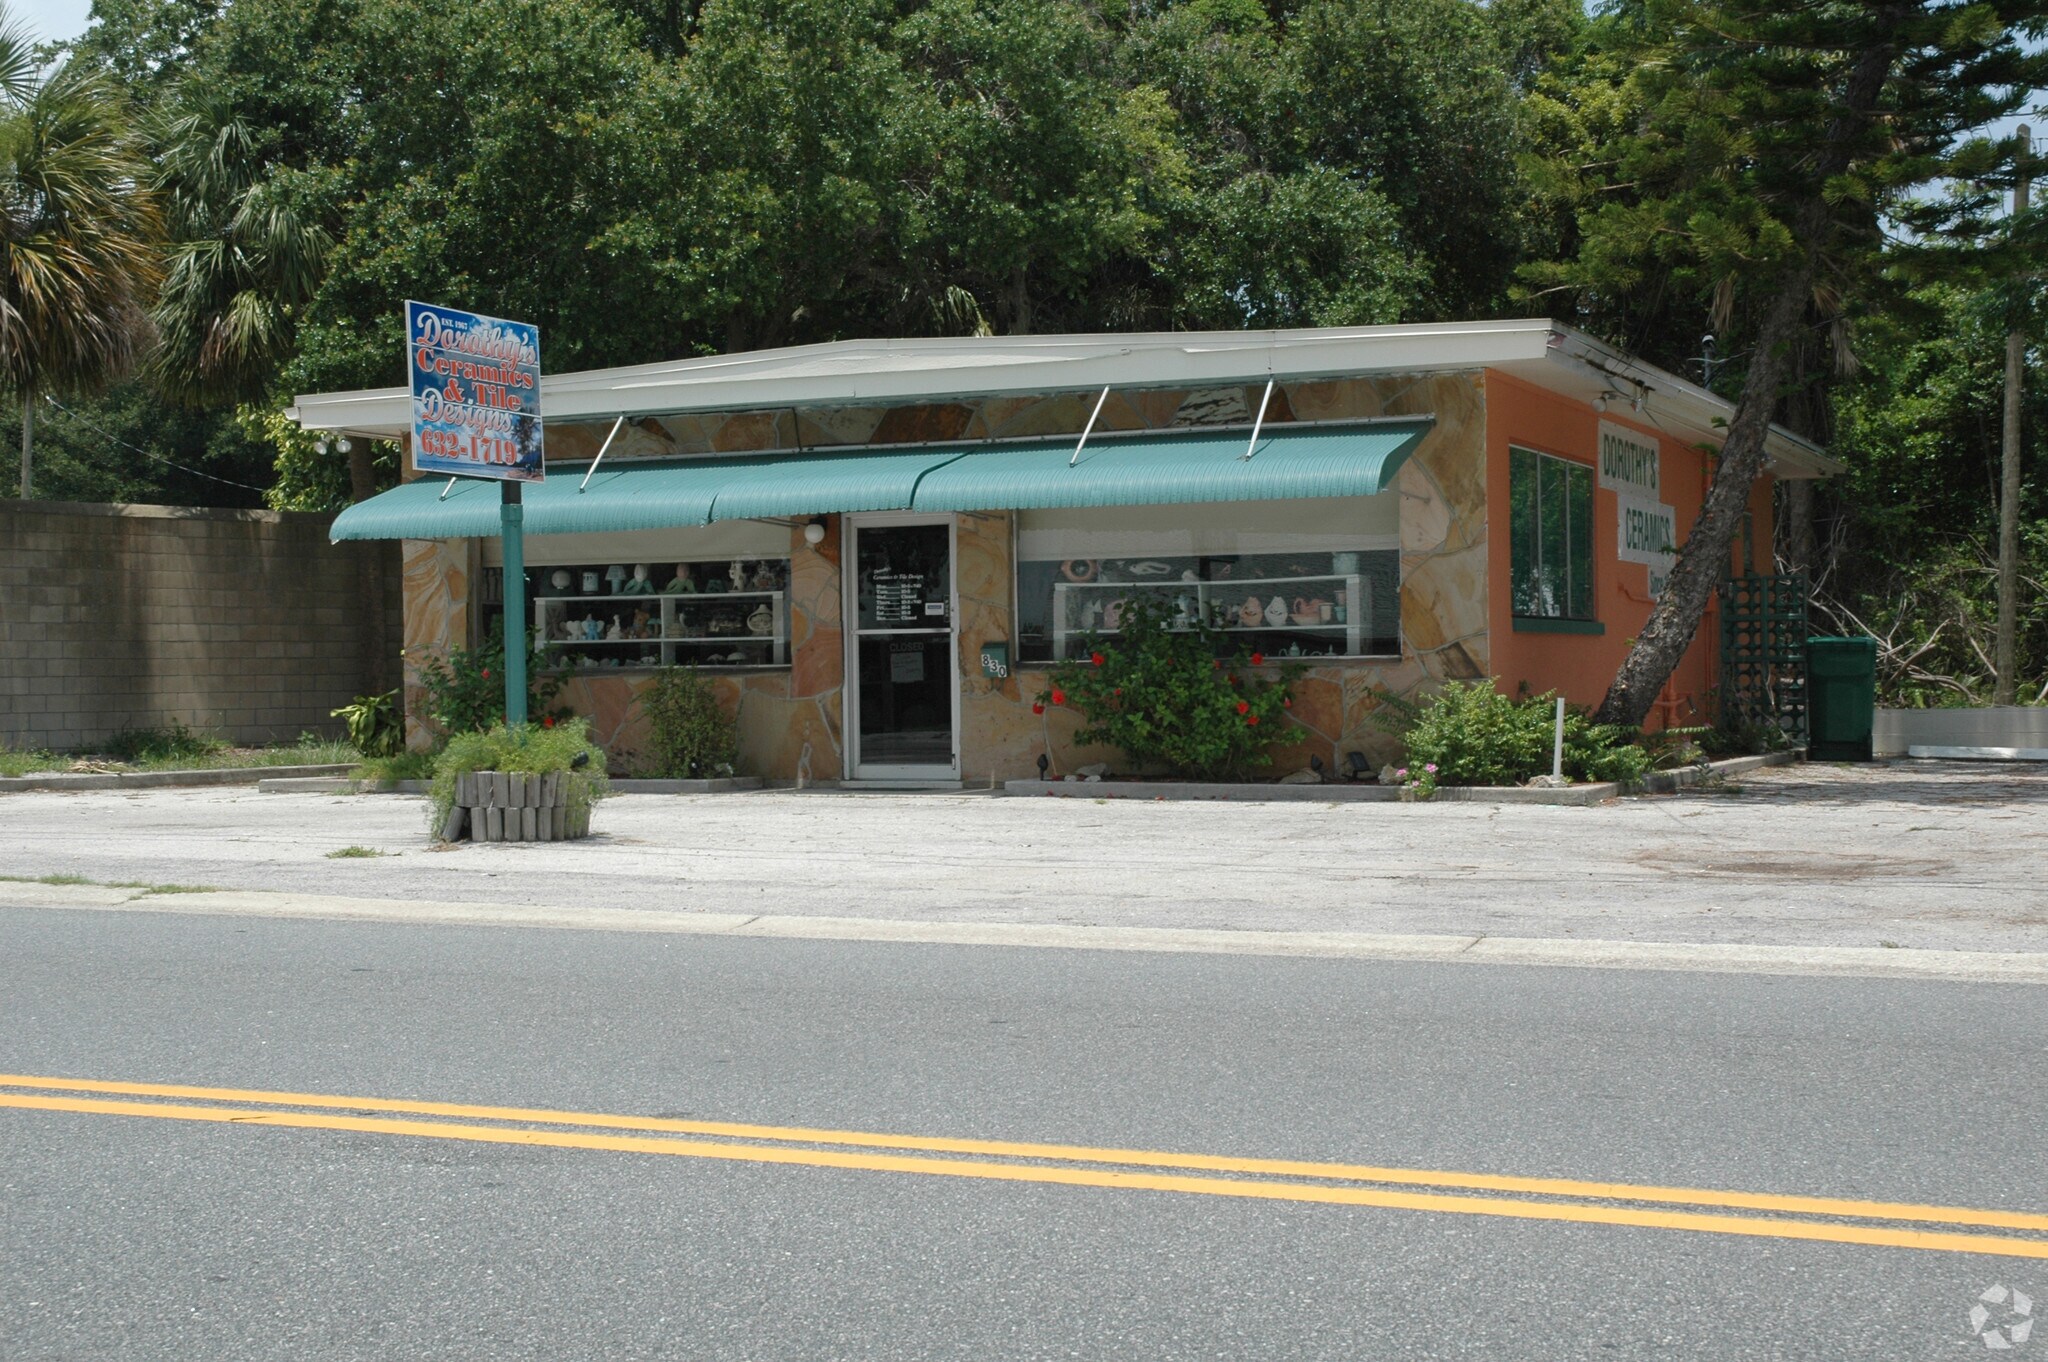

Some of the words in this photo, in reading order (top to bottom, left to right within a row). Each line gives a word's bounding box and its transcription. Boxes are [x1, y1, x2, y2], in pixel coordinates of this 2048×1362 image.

[416, 311, 537, 370] Dorothy's
[416, 347, 534, 390] Ceramics
[421, 387, 512, 436] Designs
[443, 377, 465, 403] &
[472, 382, 522, 412] Tile
[421, 428, 517, 466] 632-1719
[1603, 433, 1657, 490] DOROTHY'S
[1626, 506, 1671, 555] CERAMICS
[889, 641, 925, 652] CLOSED
[982, 655, 1007, 677] 830
